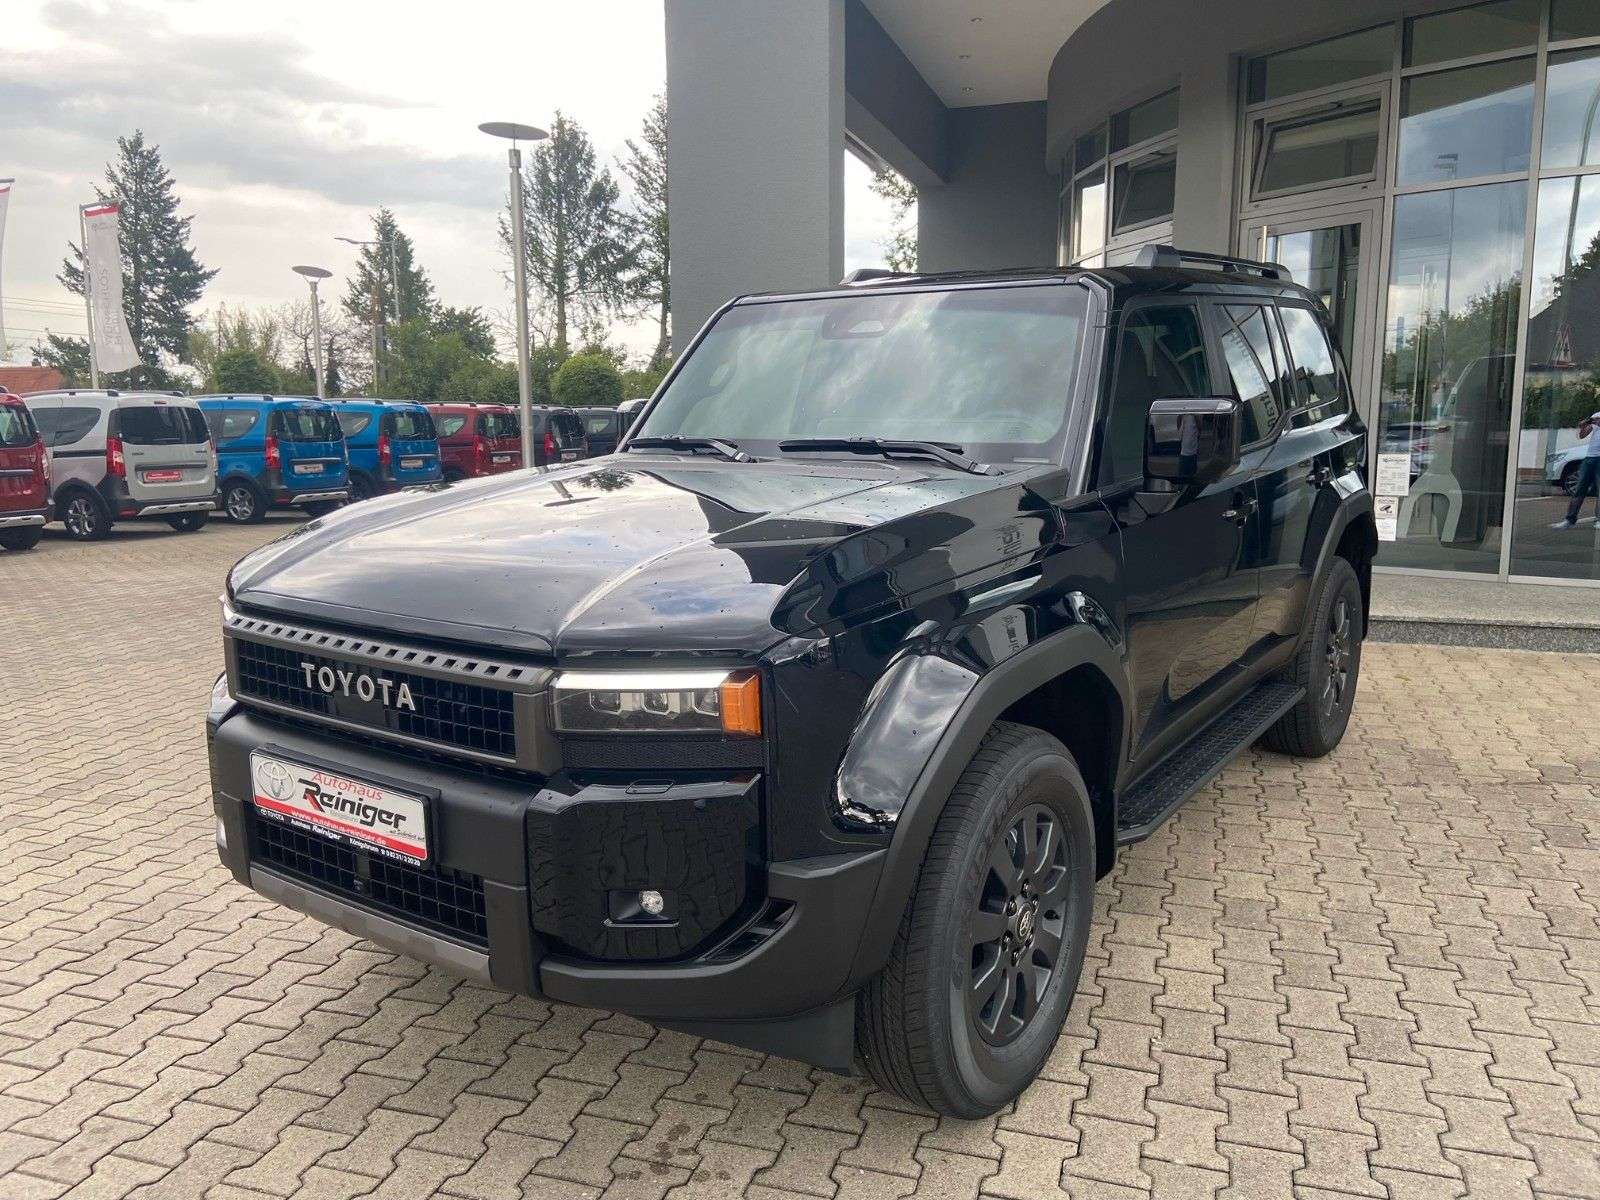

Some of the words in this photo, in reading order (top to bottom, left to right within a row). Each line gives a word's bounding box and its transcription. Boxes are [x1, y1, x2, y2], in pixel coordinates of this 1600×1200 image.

[301, 662, 416, 711] TOYOTA
[298, 778, 407, 828] Reiniger
[311, 772, 383, 801] Autohaus
[312, 826, 341, 840] Reiniger
